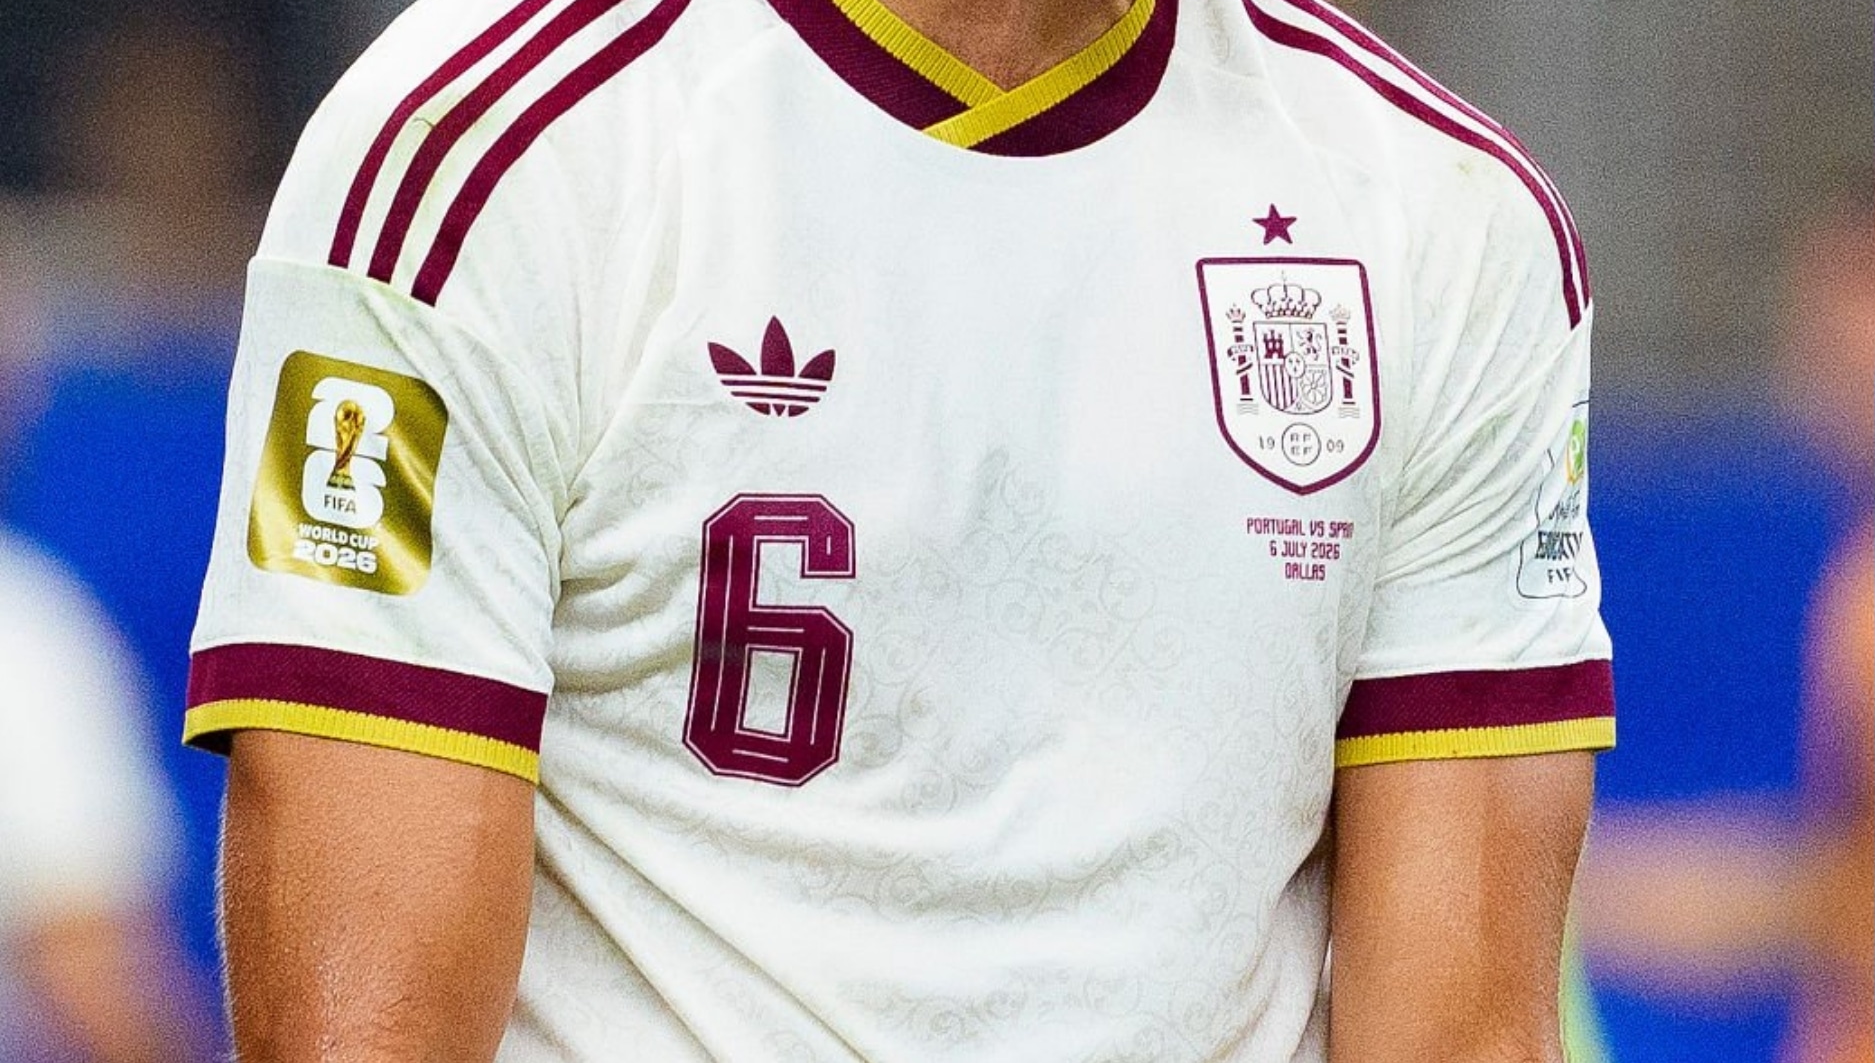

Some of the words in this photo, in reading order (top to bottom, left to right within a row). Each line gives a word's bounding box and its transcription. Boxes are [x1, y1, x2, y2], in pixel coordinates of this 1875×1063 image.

[324, 494, 356, 514] FIFA
[299, 523, 348, 545] WORLD
[349, 533, 379, 550] CUP
[1246, 518, 1305, 536] PORTUGAL
[1310, 520, 1325, 537] VS
[294, 539, 378, 574] 2026
[1269, 540, 1277, 557] 6
[1281, 541, 1307, 558] JULY
[1311, 542, 1340, 560] 2026
[1285, 562, 1326, 581] DALLAS
[1547, 567, 1572, 583] FIF
[682, 493, 855, 788] 6
